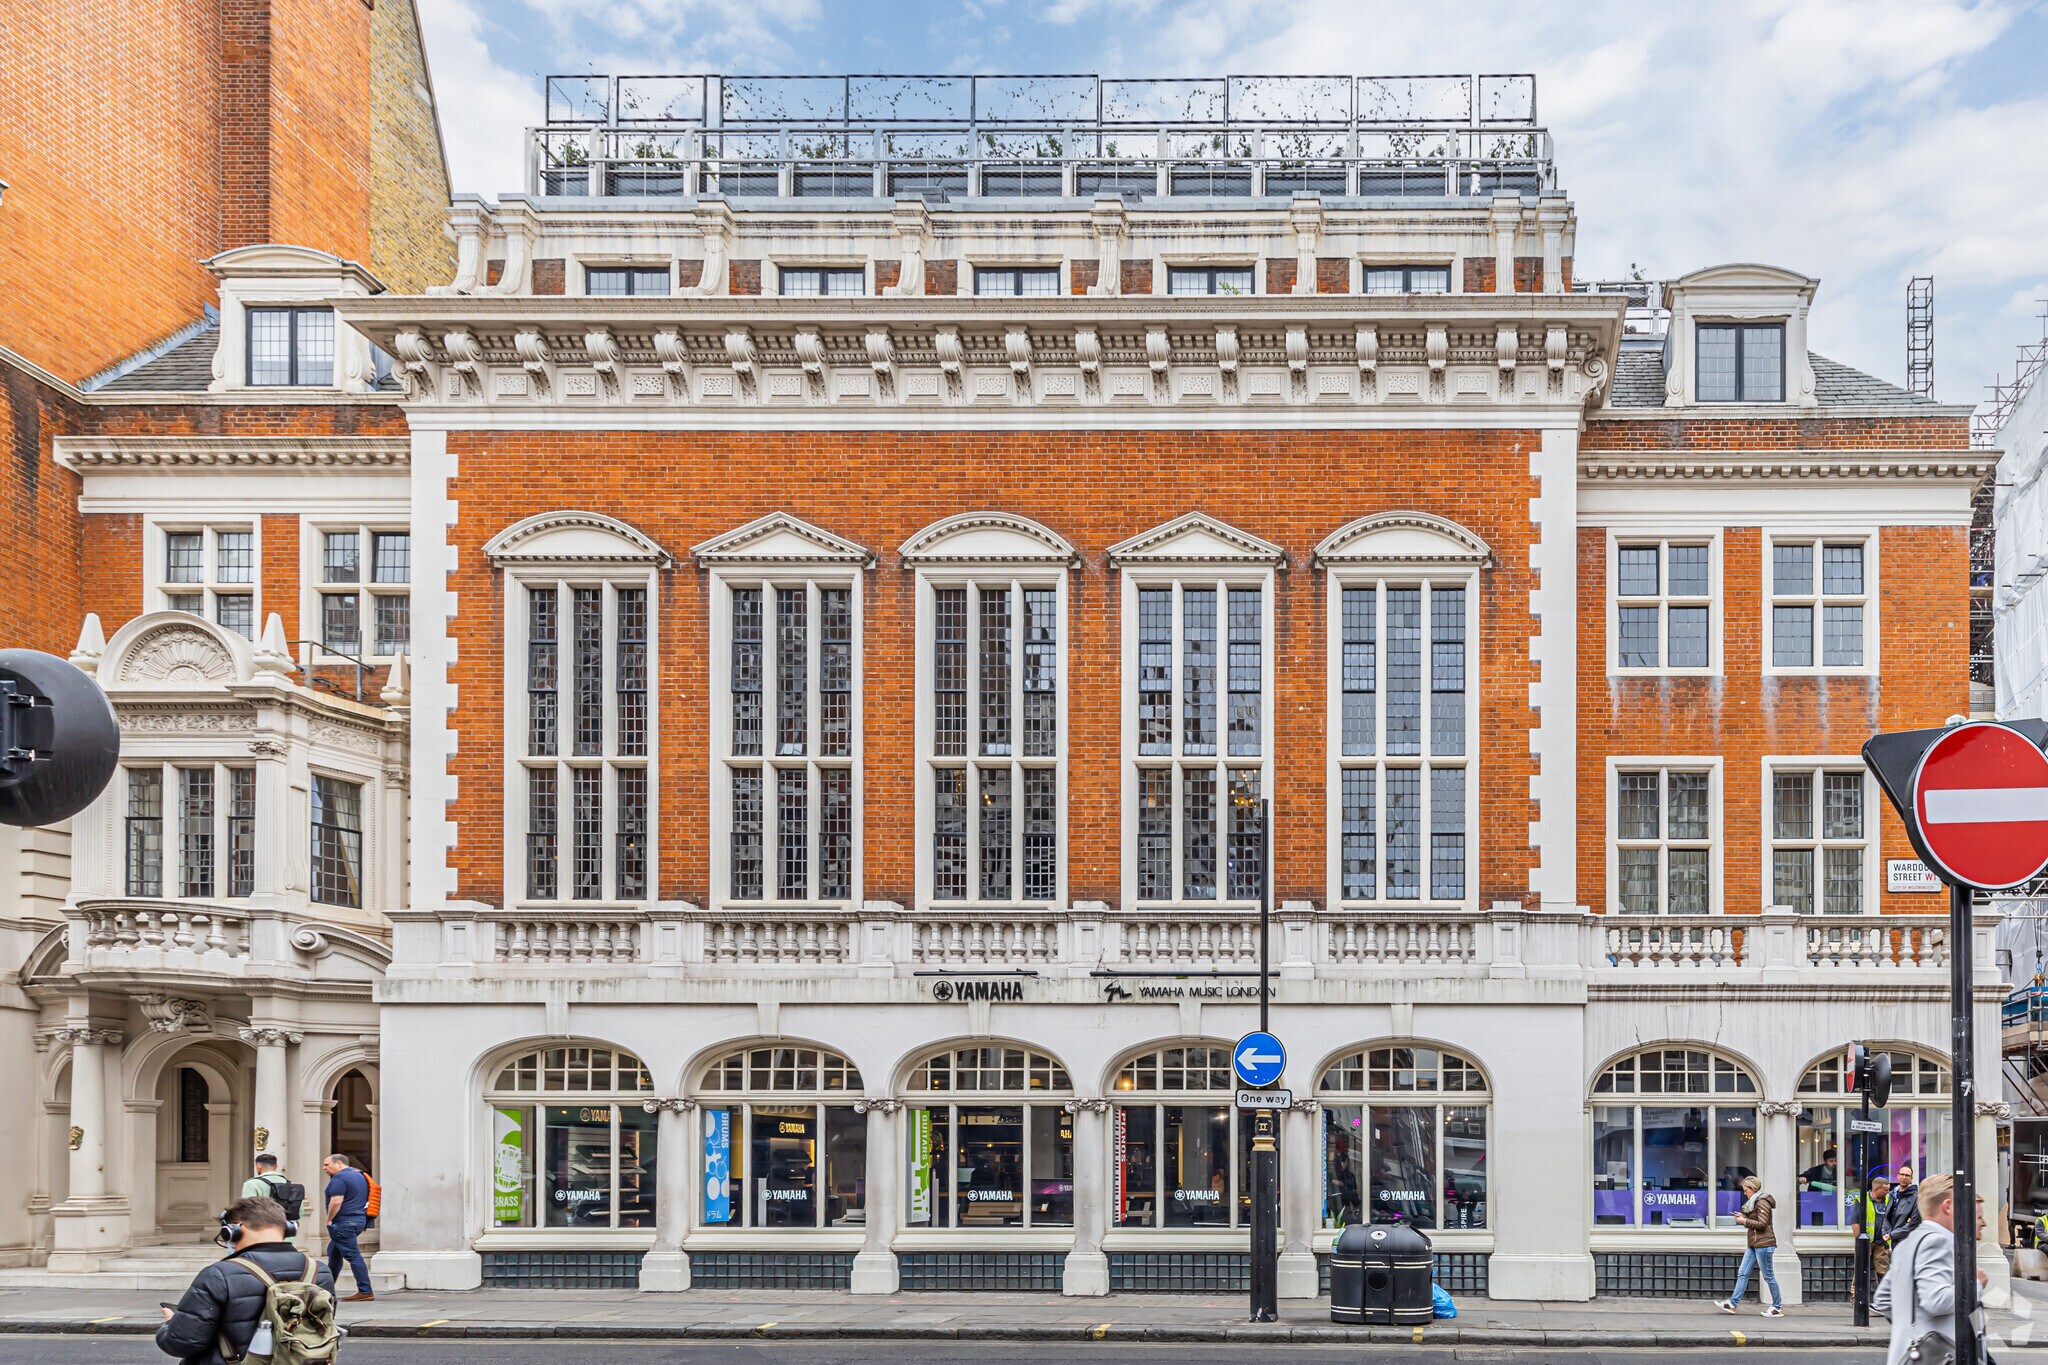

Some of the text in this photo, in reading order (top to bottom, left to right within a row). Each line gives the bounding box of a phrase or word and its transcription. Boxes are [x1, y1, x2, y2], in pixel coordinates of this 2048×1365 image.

[1893, 873, 1922, 881] STREET
[955, 981, 1023, 1000] YAMAHA
[1139, 986, 1185, 998] YAMAHA
[1189, 986, 1223, 998] MUSIC
[1241, 1094, 1287, 1105] One way
[590, 1109, 623, 1122] YAMAA
[721, 1112, 729, 1149] DRUMS
[785, 1123, 805, 1134] YAMAHA
[566, 1190, 601, 1201] YAMAHA
[771, 1189, 808, 1200] YAMAHA
[977, 1190, 1013, 1201] YAMAHA
[1185, 1190, 1220, 1200] YAMAHA
[1391, 1190, 1426, 1201] YAMAHA
[1656, 1194, 1696, 1205] YAMAHA
[1460, 1208, 1468, 1229] SPIRE
